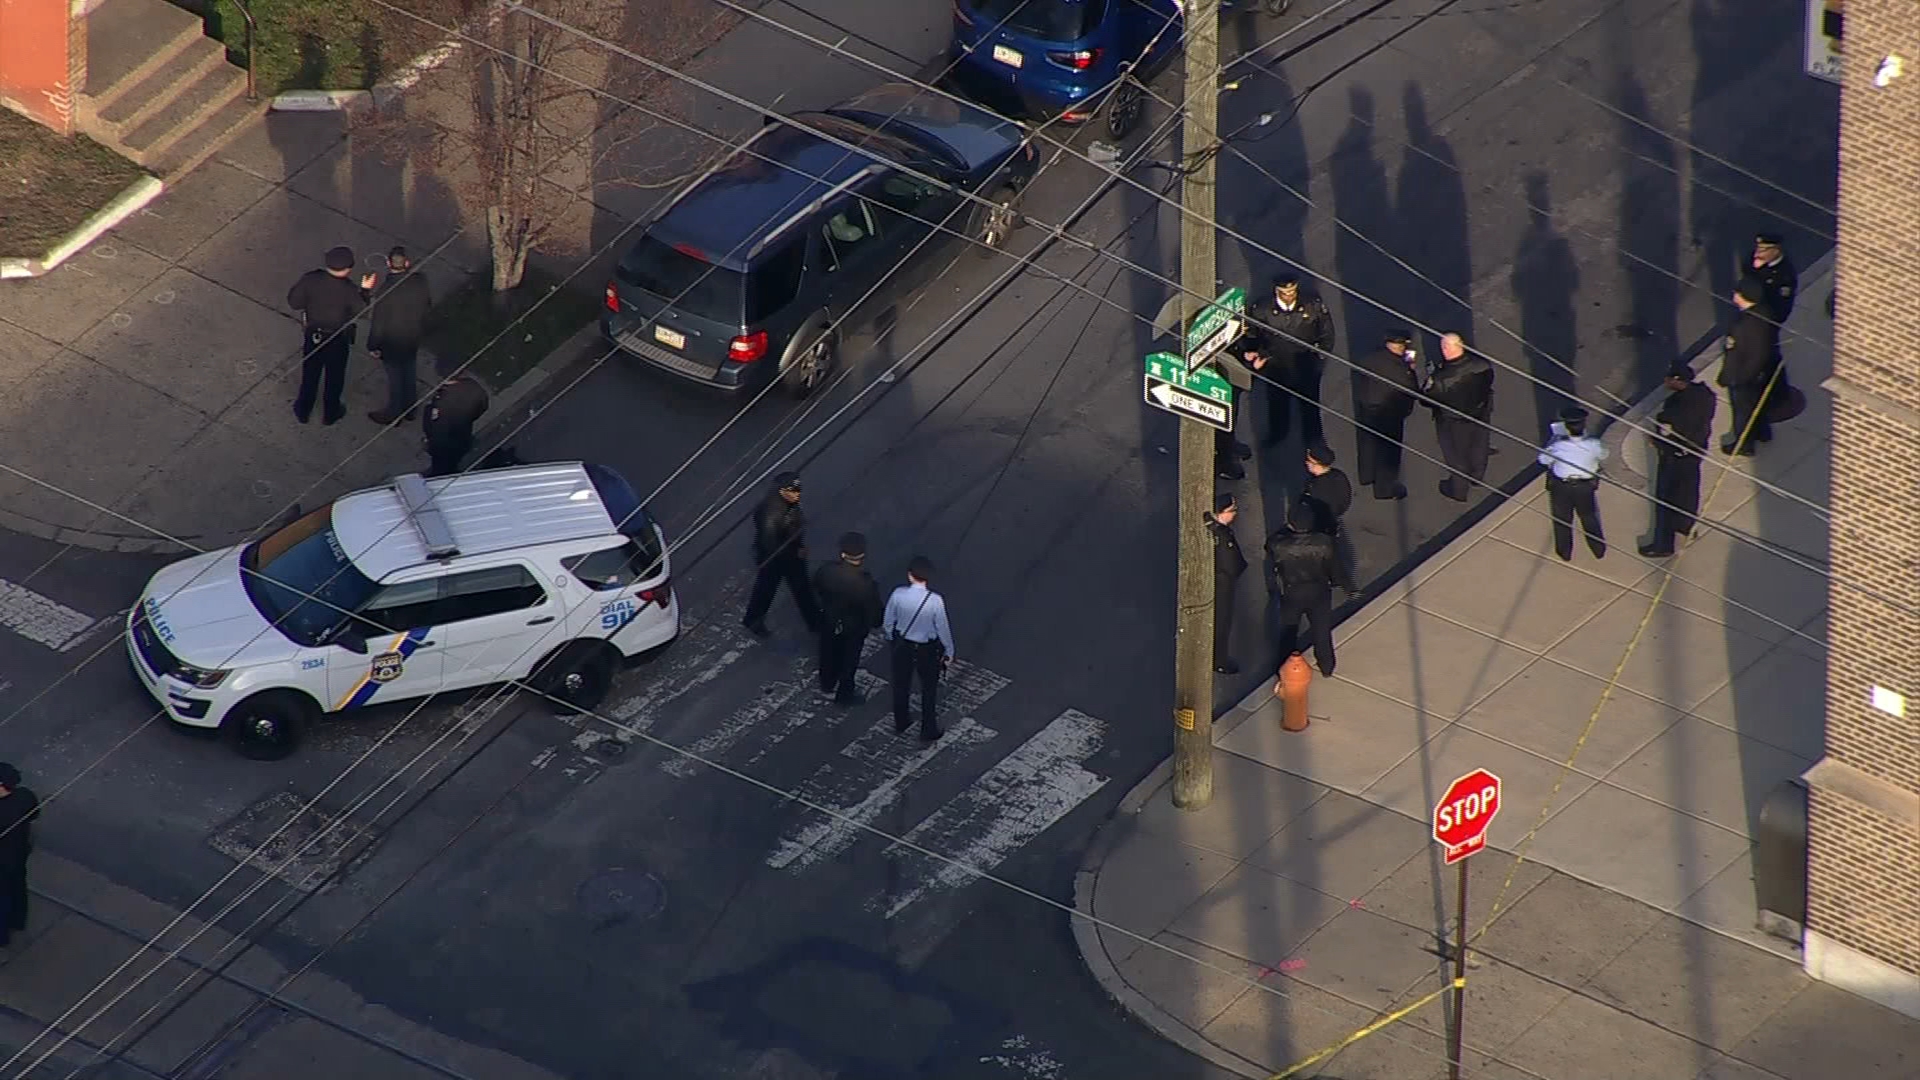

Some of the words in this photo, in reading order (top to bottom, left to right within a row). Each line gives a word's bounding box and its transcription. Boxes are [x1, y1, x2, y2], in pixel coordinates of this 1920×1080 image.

[1171, 393, 1193, 409] ONE
[1198, 403, 1221, 418] WAY
[1210, 386, 1227, 401] ST
[324, 530, 345, 562] POLICE
[145, 598, 176, 641] POLICE
[600, 601, 633, 614] DIAL
[1439, 785, 1496, 833] STOP
